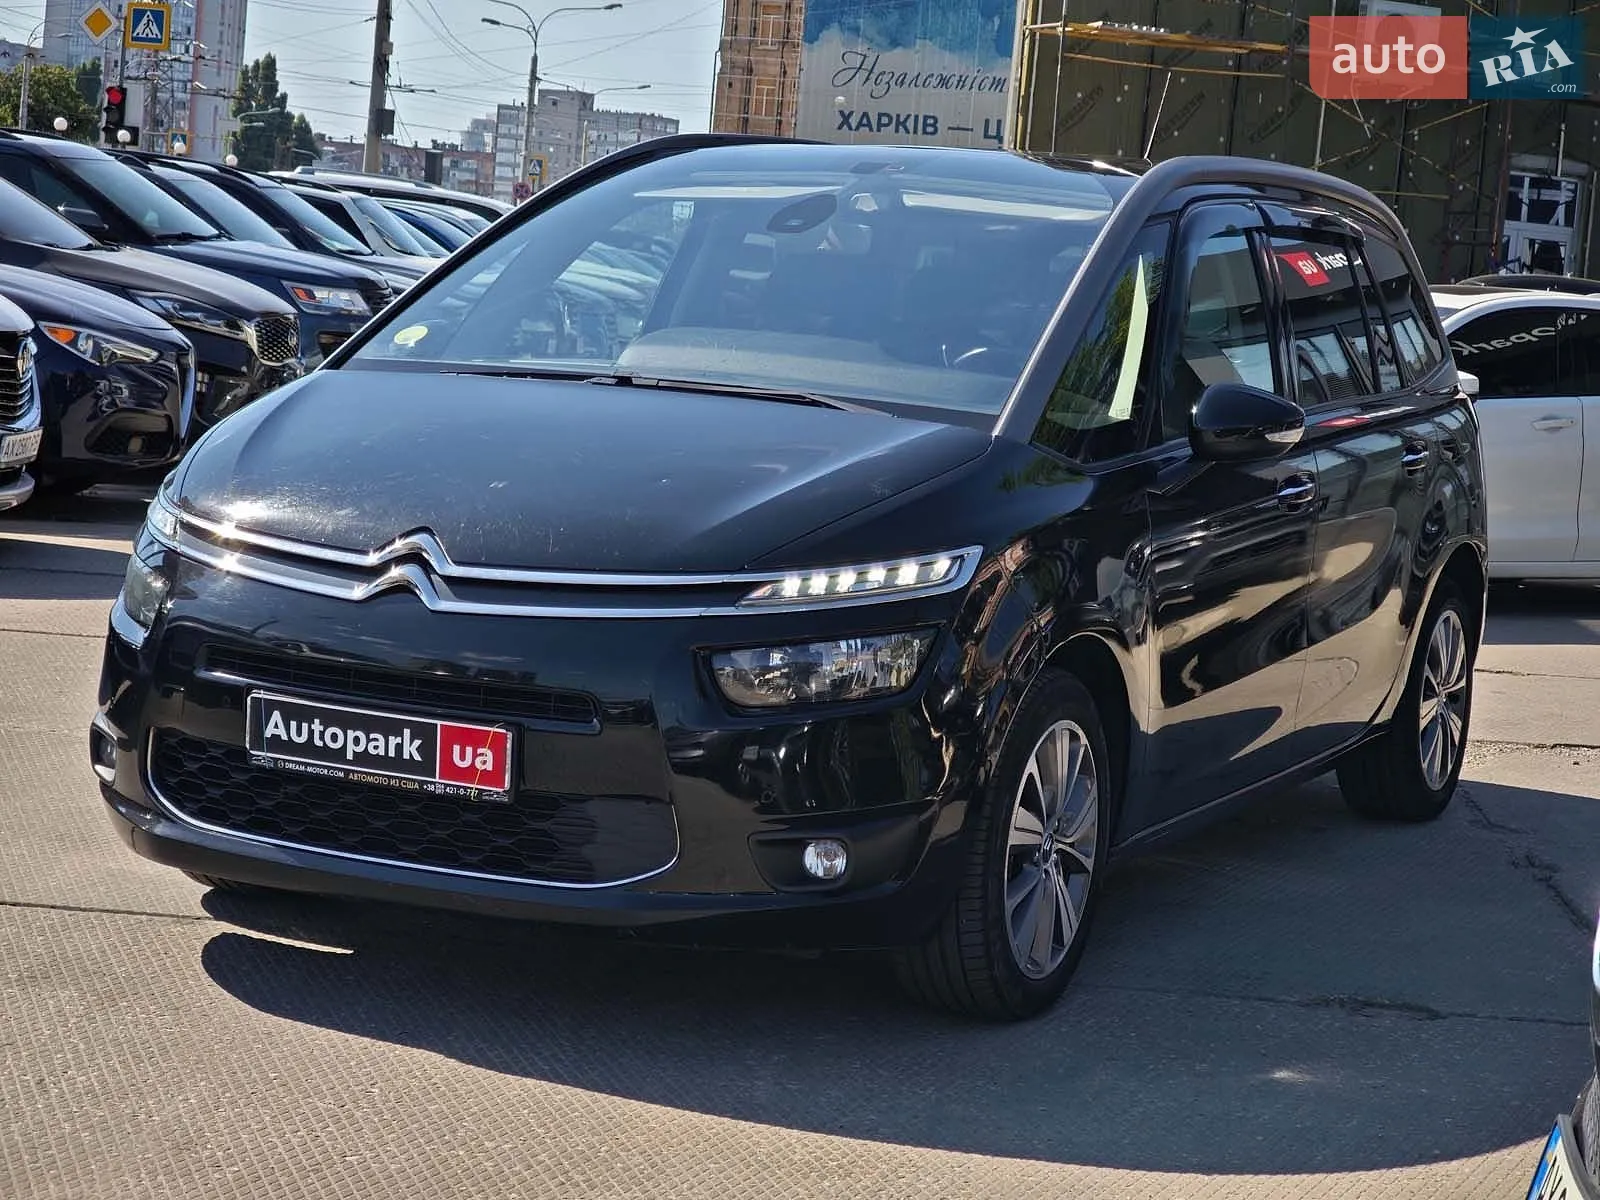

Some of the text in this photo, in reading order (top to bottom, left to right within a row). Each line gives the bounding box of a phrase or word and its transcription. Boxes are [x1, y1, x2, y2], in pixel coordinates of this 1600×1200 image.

[837, 110, 939, 136] ХАРКІВ
[264, 710, 494, 772] Autopark ua
[400, 779, 419, 790] США
